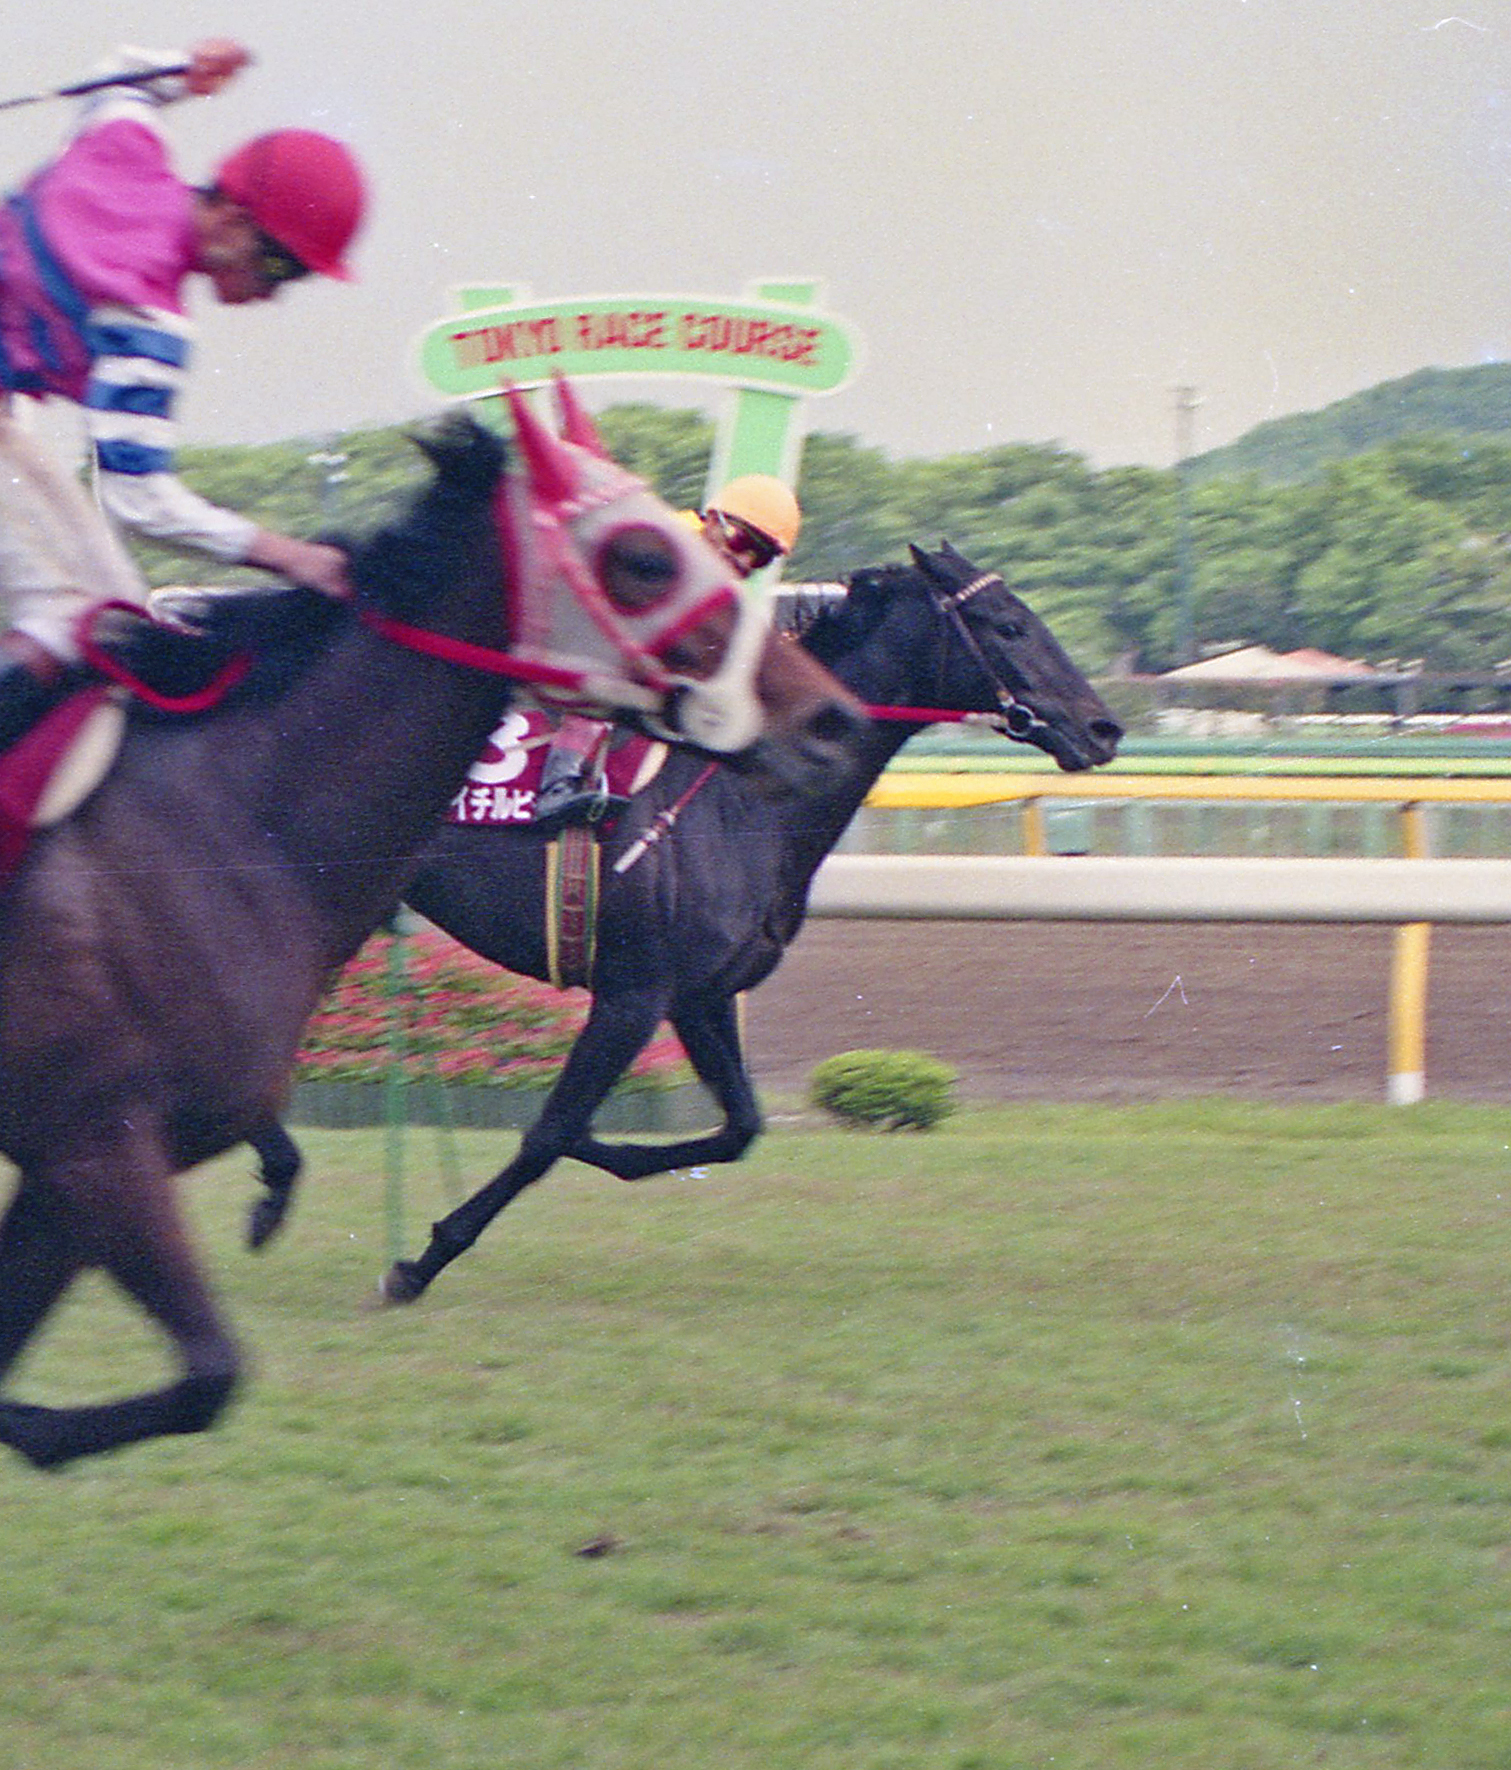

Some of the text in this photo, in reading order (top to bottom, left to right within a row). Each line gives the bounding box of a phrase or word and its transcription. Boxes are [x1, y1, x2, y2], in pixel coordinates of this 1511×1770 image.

[449, 311, 820, 370] TOKYO RACE COURSE
[468, 712, 530, 784] 3
